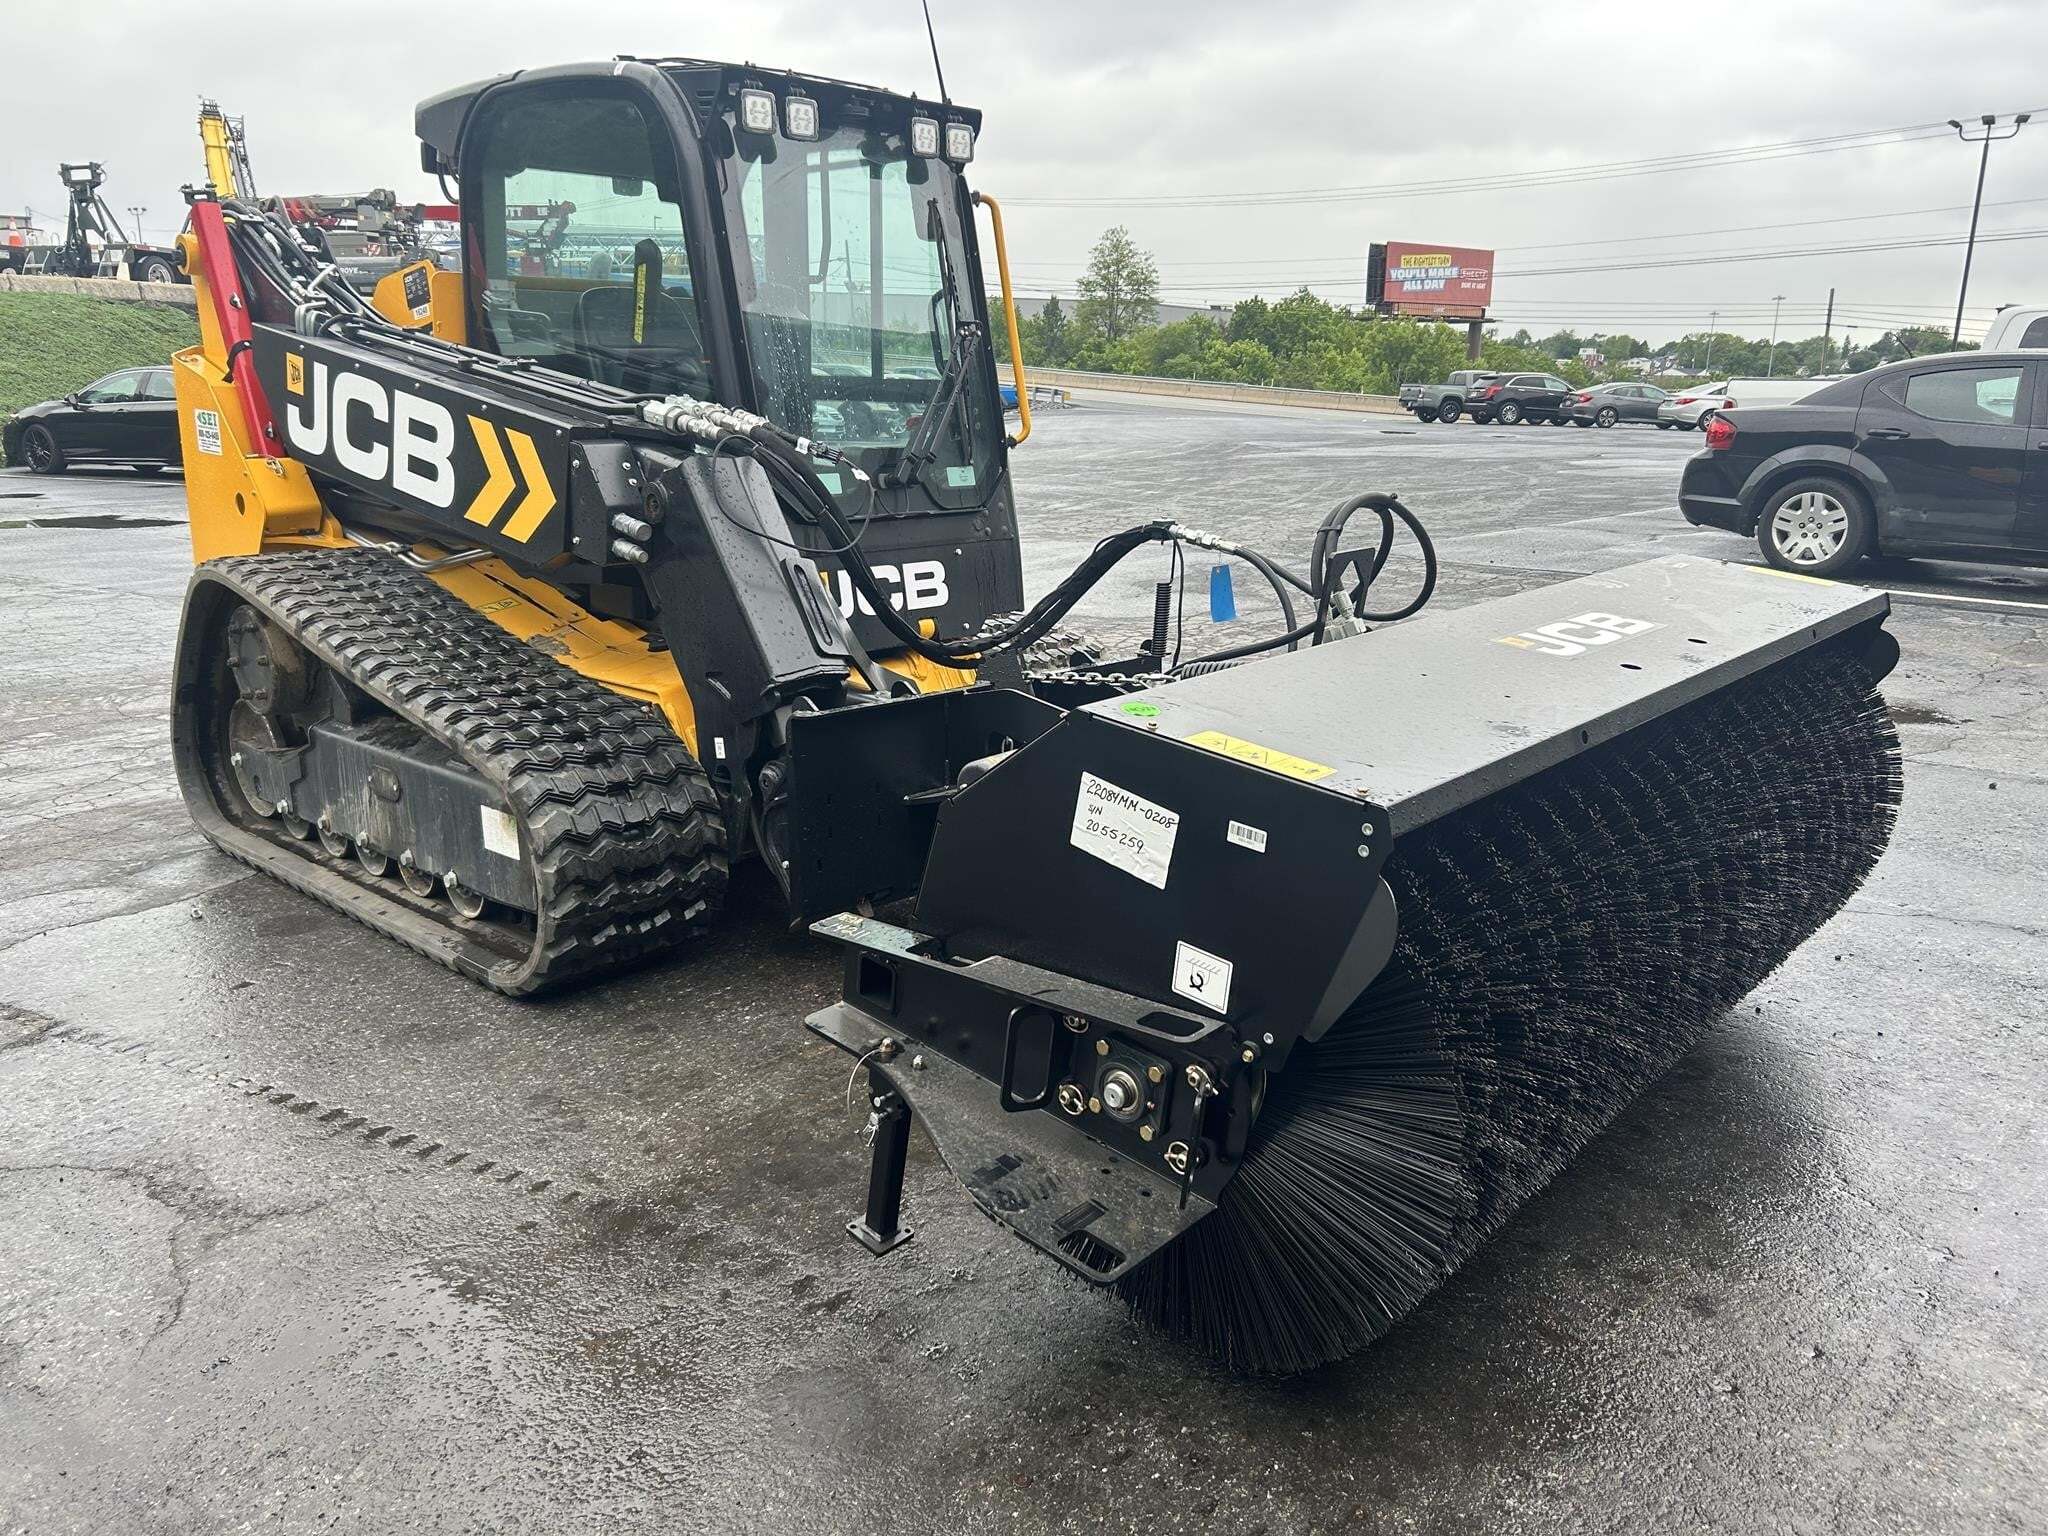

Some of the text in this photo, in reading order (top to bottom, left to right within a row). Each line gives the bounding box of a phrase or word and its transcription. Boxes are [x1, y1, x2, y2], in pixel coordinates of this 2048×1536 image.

[1403, 256, 1413, 267] THE
[1390, 267, 1459, 280] YOU'LL MAKE
[1403, 279, 1445, 290] ALL DAY
[202, 412, 217, 426] SEI
[287, 361, 455, 508] JCB
[828, 560, 949, 619] JCB
[1518, 612, 1655, 656] JCB
[1088, 804, 1103, 816] S/N
